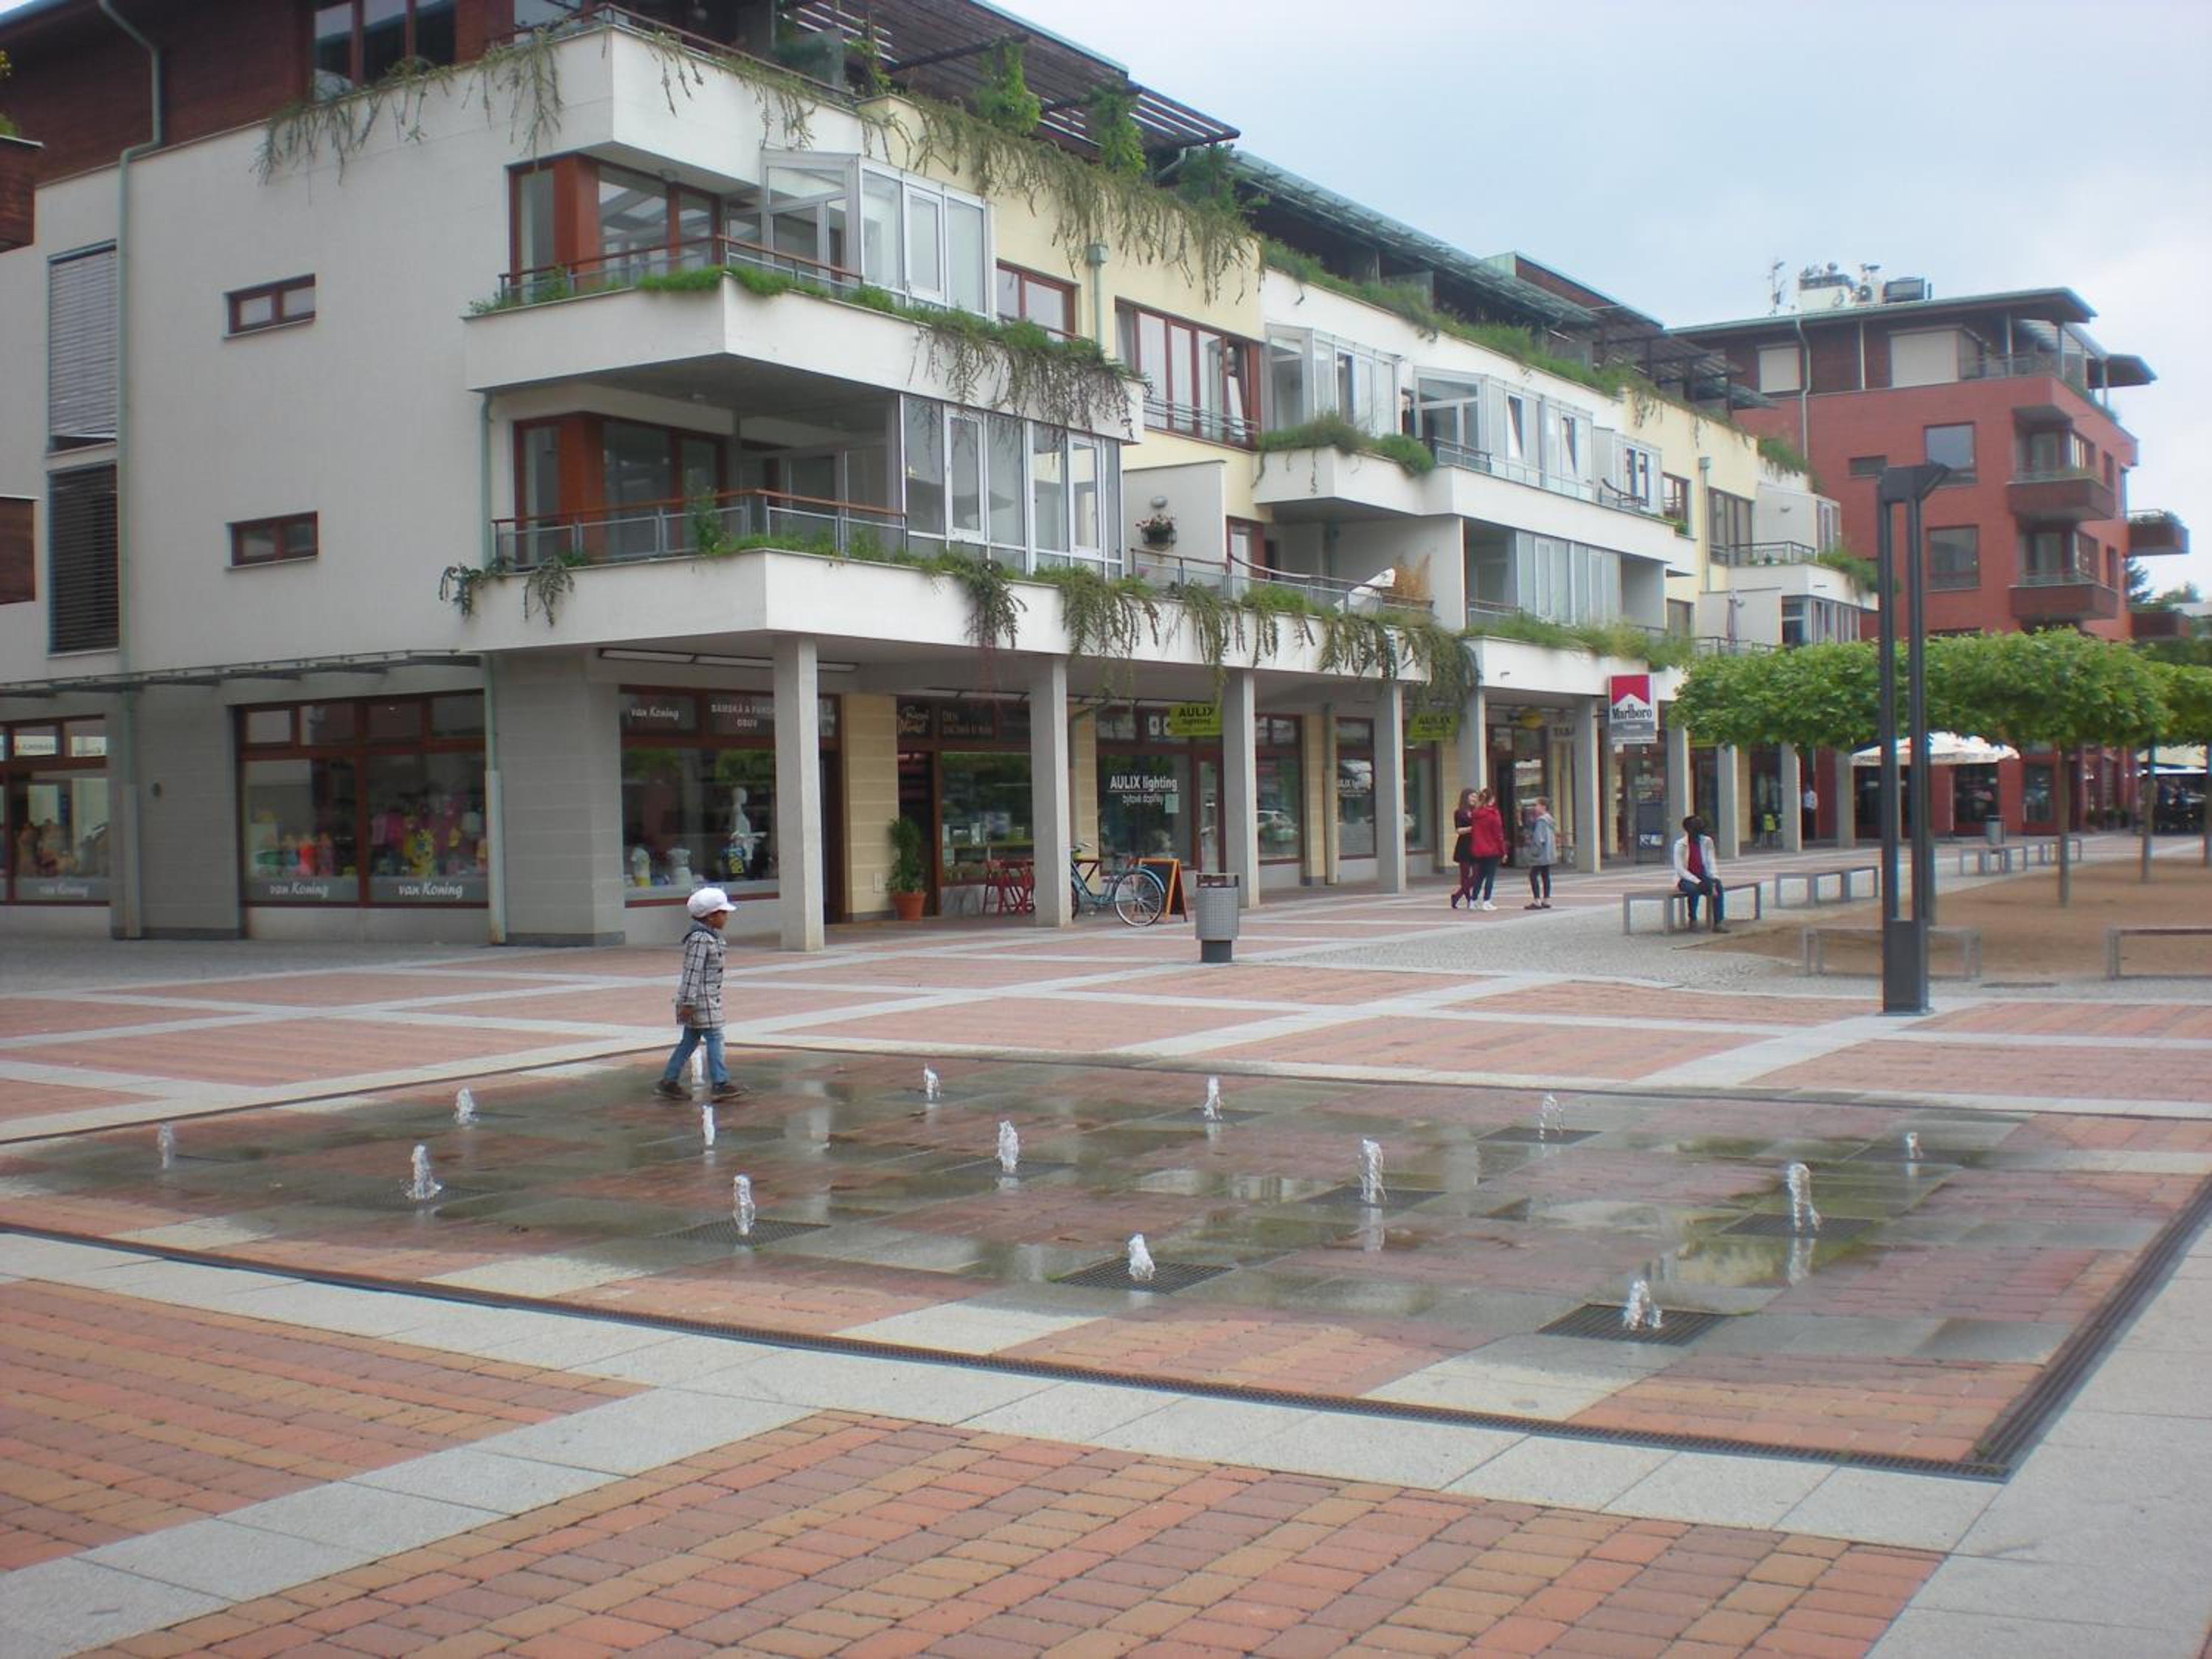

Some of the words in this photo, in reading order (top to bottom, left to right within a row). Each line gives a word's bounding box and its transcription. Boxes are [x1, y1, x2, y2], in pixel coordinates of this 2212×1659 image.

[1179, 706, 1214, 717] AULIX
[1613, 703, 1652, 720] Marlboro
[1110, 776, 1141, 790] AULIX
[1142, 775, 1178, 793] lighting
[270, 885, 288, 894] van
[292, 882, 329, 898] Koning
[399, 884, 420, 895] van
[422, 882, 464, 899] Koning
